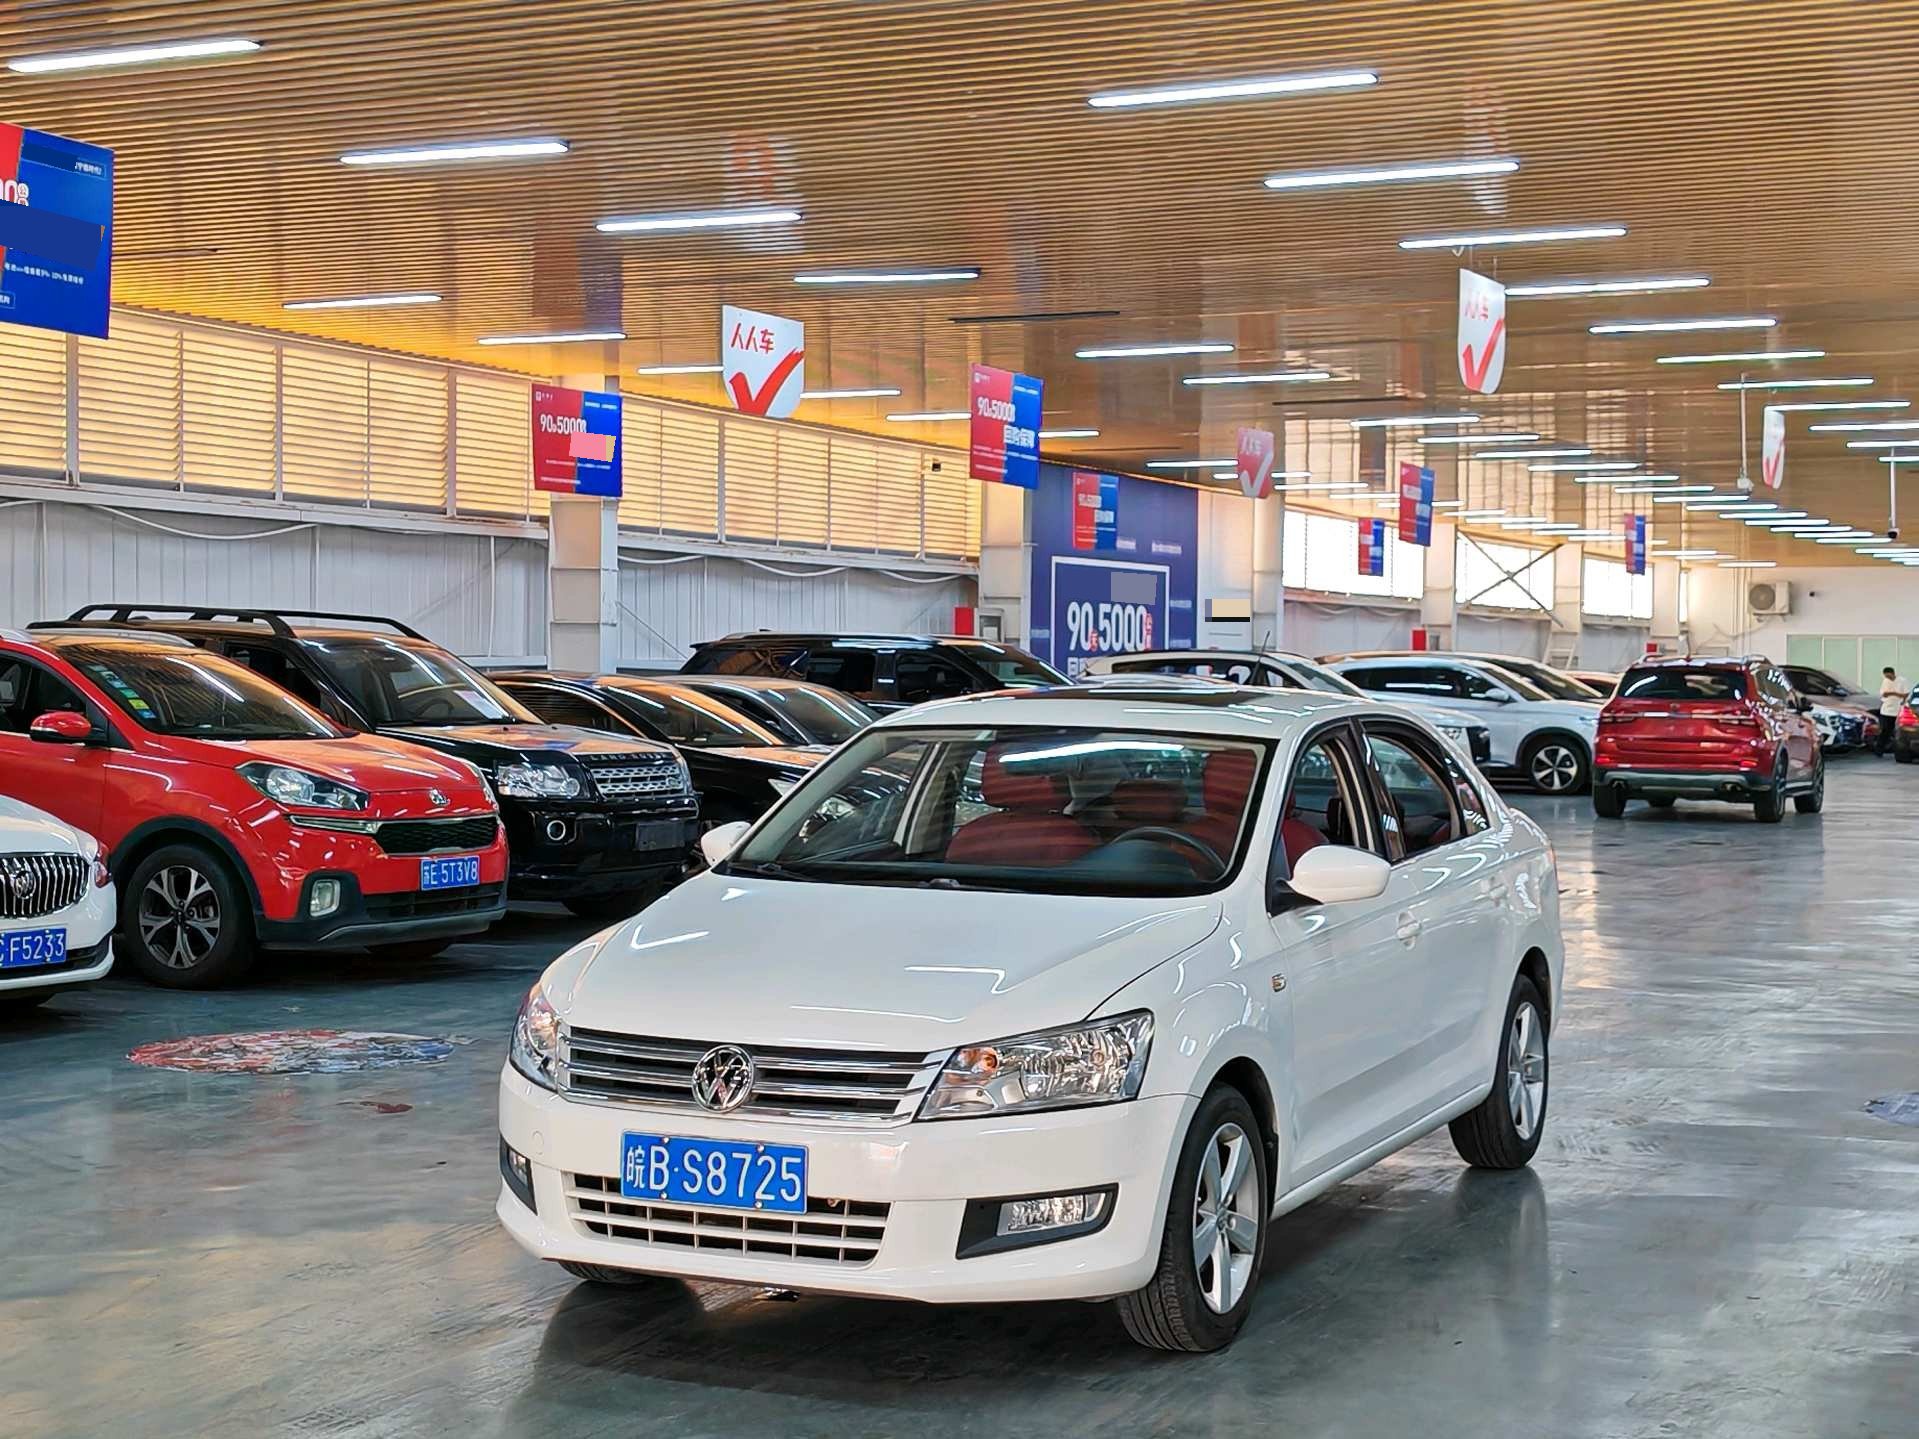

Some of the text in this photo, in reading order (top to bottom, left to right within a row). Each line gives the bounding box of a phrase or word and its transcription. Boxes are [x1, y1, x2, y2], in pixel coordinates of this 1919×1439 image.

[731, 322, 775, 354] 人人车
[626, 1144, 802, 1203] 皖B·S8725
